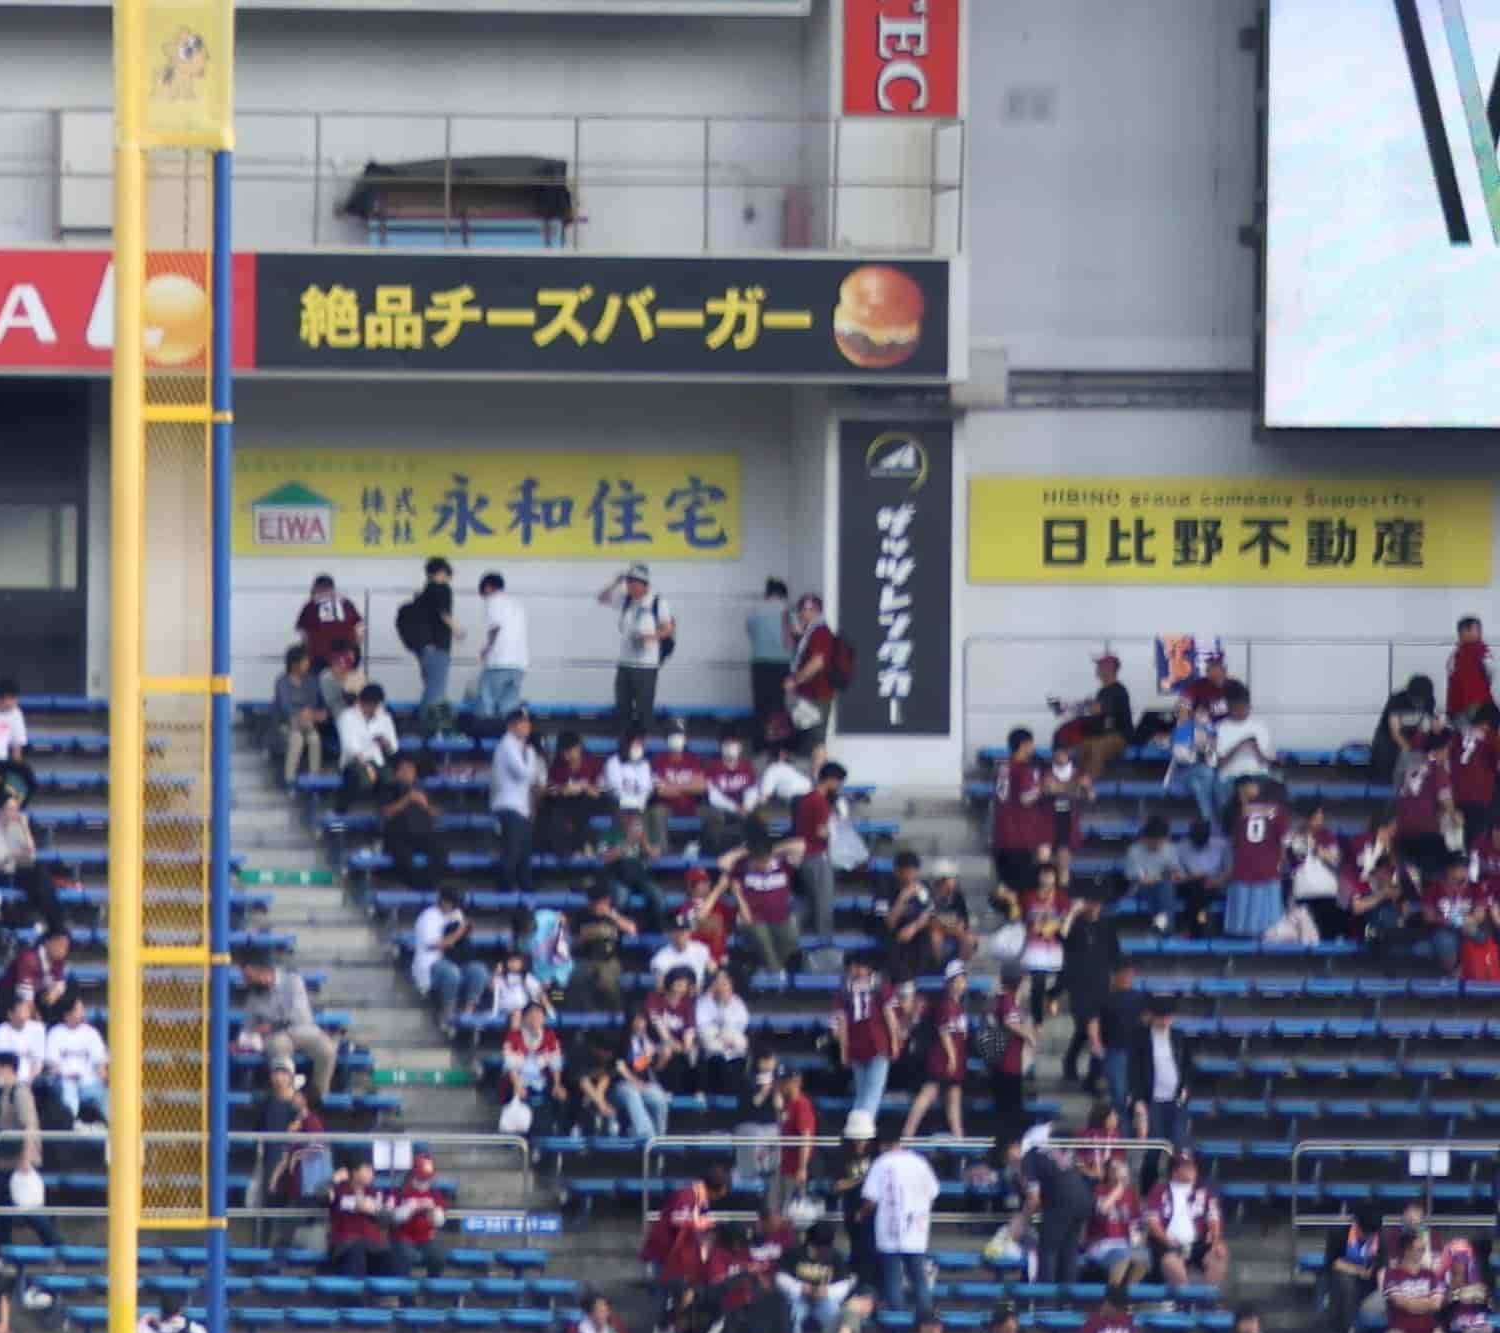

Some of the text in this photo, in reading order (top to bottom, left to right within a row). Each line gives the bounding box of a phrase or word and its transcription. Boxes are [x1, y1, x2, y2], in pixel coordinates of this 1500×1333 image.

[876, 0, 929, 112] EC
[300, 286, 810, 349] 絶品チーズバーガー
[257, 514, 327, 542] EIWA
[429, 473, 729, 548] 永和住宅
[1041, 516, 1426, 570] 日比野不動産
